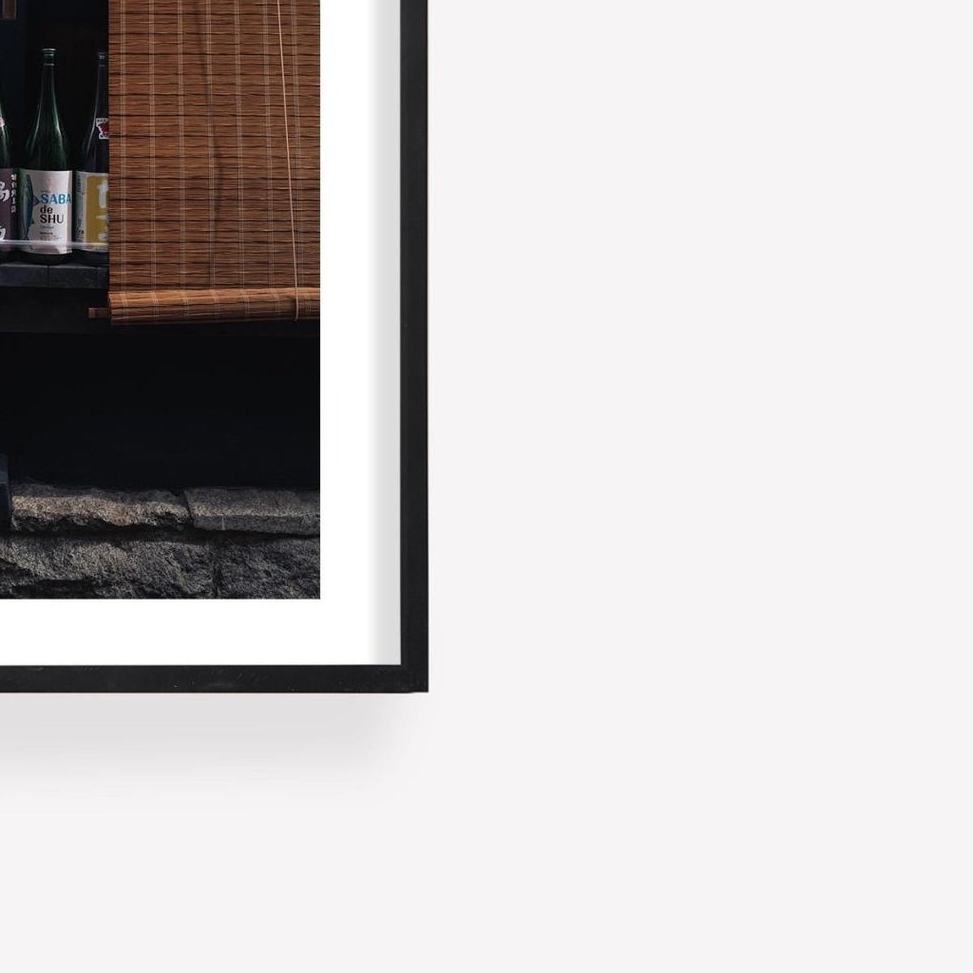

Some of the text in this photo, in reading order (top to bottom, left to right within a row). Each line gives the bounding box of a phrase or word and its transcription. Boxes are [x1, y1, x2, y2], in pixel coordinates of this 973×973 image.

[40, 193, 72, 205] SABA
[40, 205, 54, 214] de
[39, 214, 64, 224] SHU
